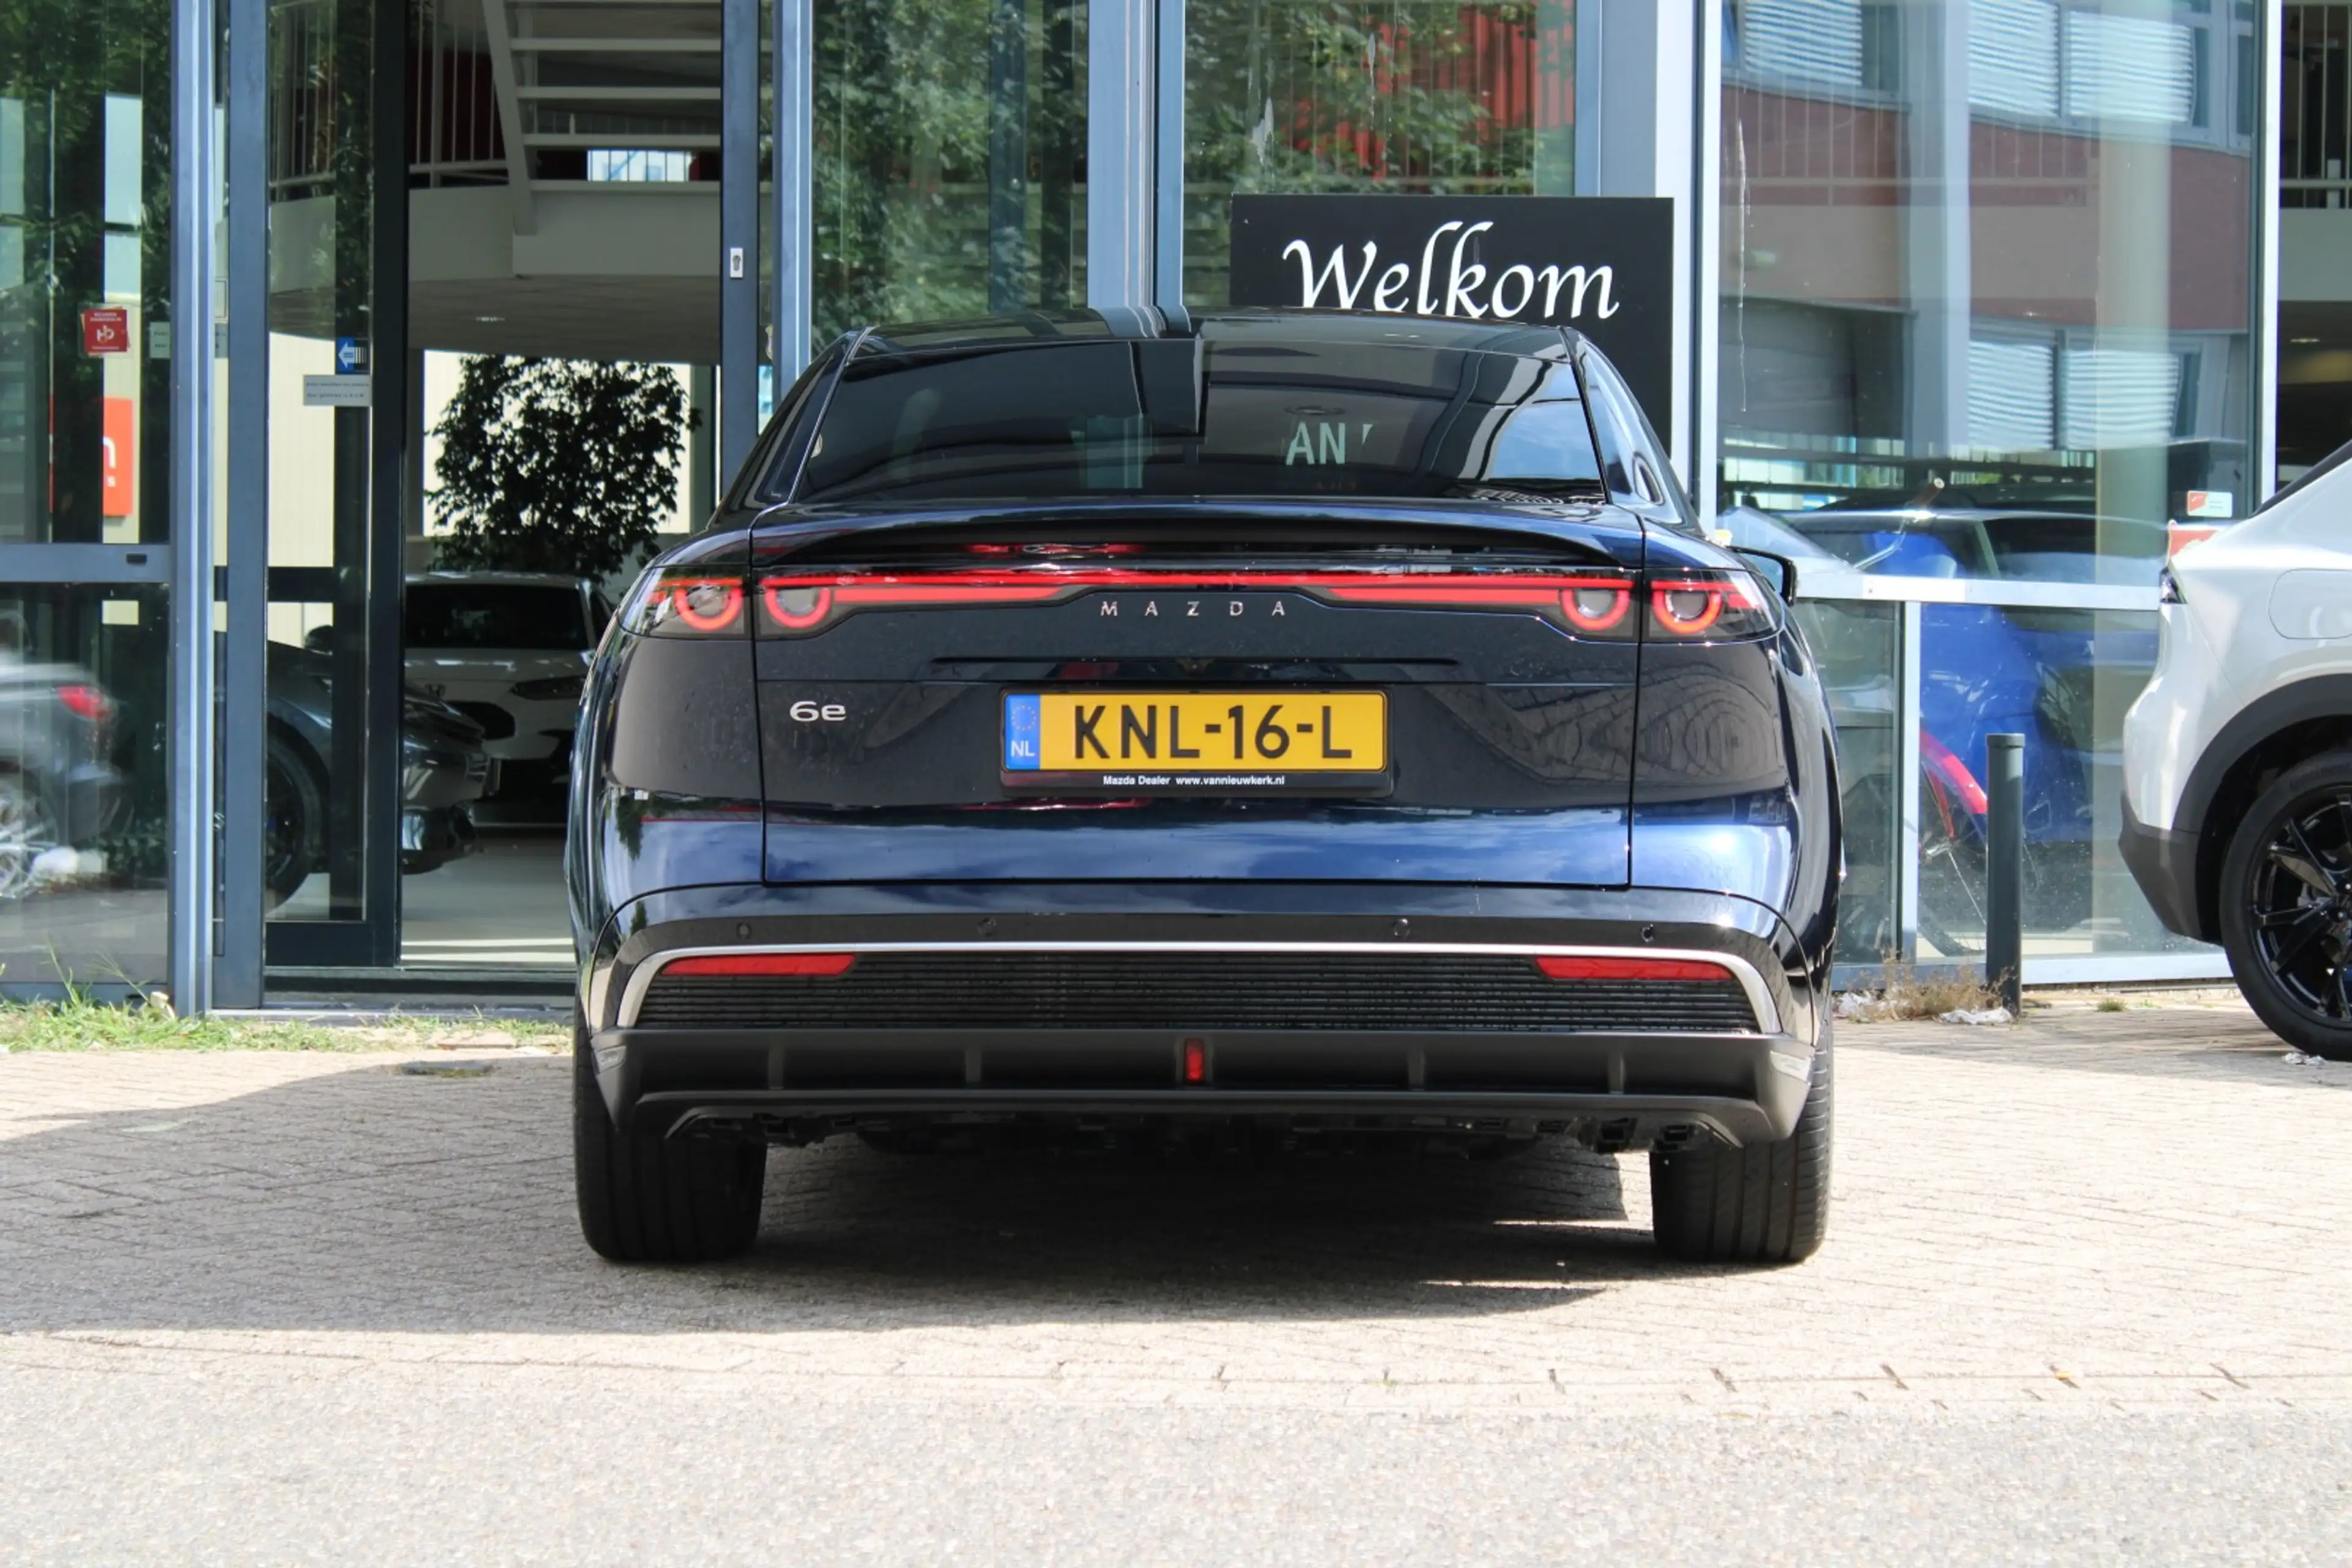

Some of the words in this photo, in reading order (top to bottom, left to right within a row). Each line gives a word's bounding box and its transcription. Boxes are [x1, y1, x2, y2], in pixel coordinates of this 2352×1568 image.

[1283, 221, 1620, 320] Welkom
[1100, 600, 1286, 617] MAZDA
[790, 700, 846, 722] 6e
[1075, 704, 1352, 759] KNL-16-L
[1011, 740, 1035, 757] NL
[1102, 775, 1136, 785] Mazda
[1137, 775, 1170, 785] Dealer
[1175, 775, 1285, 785] www.vannieuwkerk.nl
